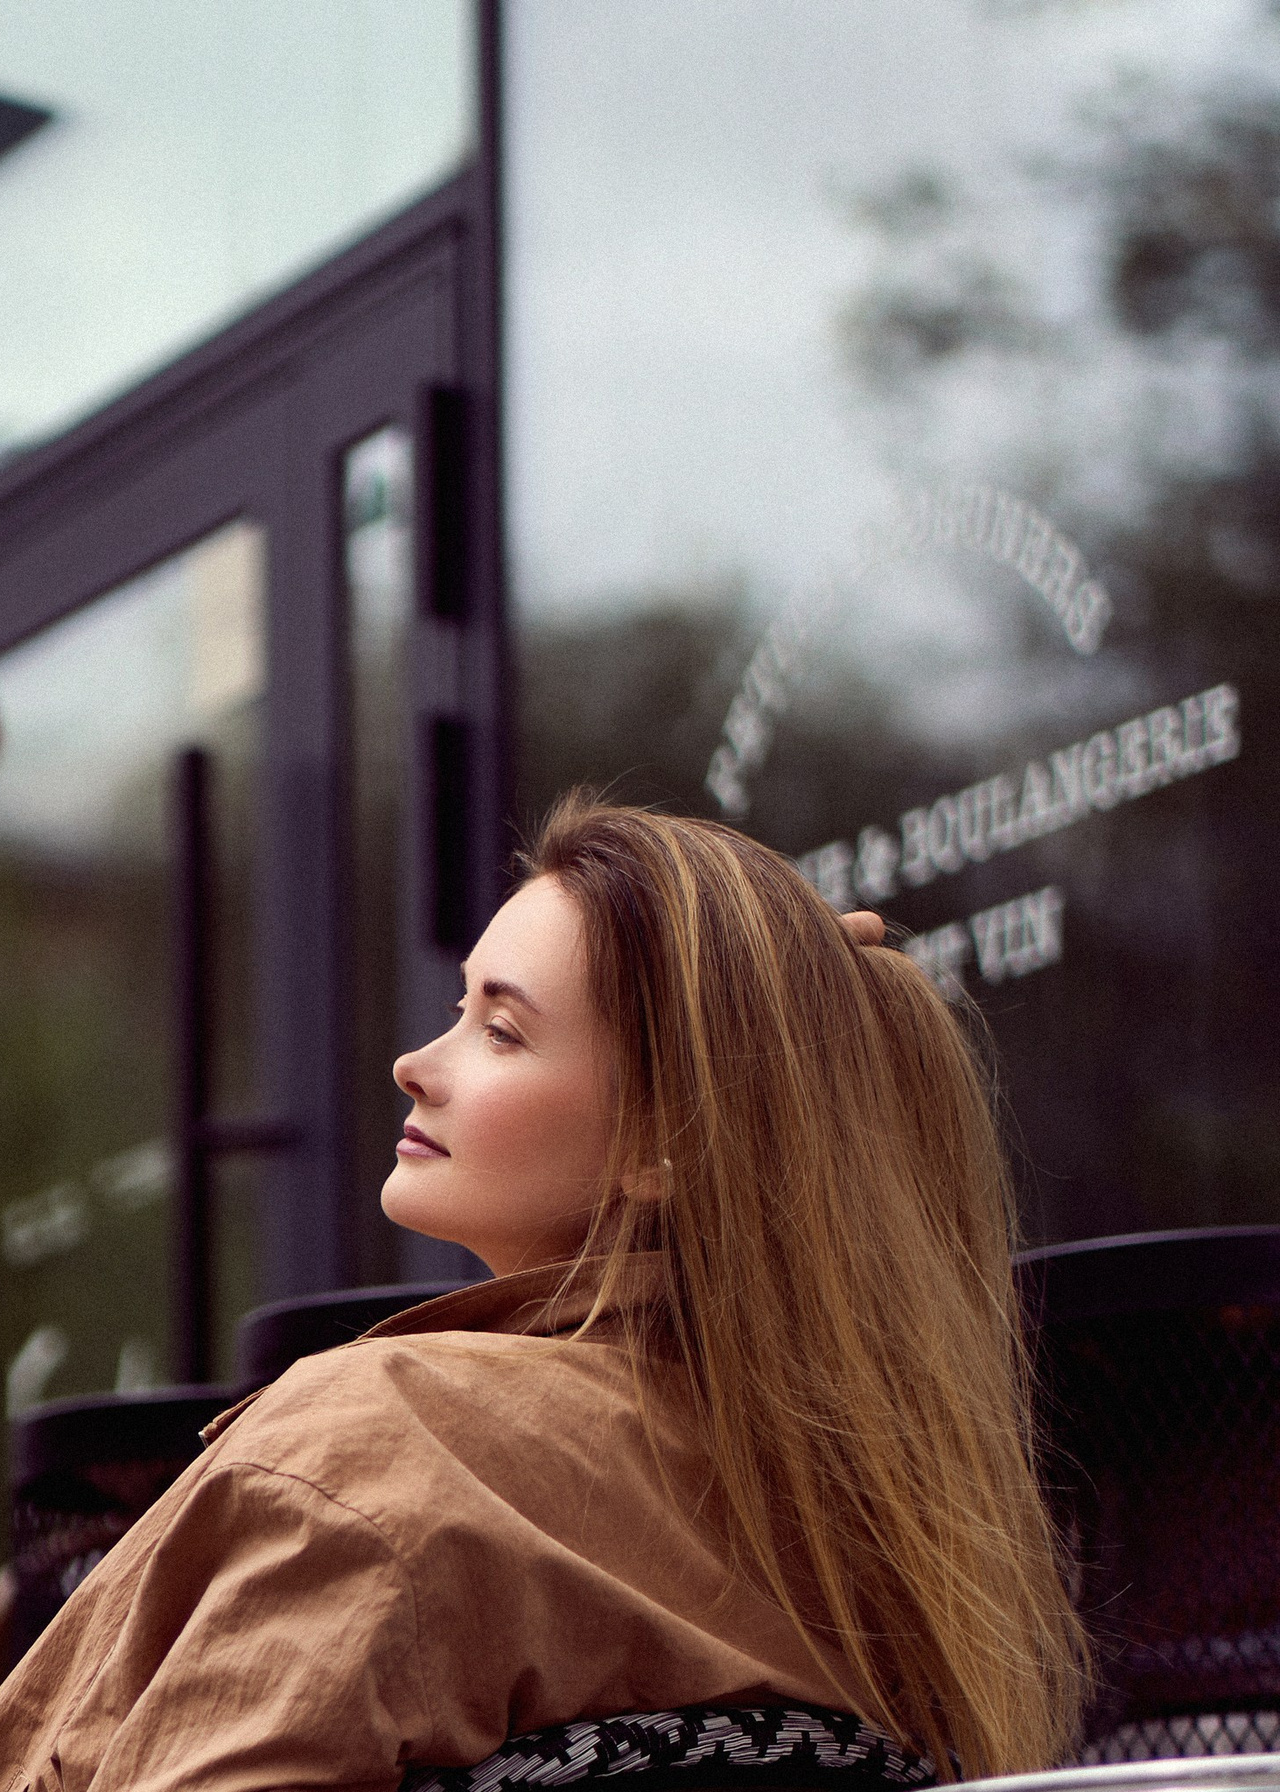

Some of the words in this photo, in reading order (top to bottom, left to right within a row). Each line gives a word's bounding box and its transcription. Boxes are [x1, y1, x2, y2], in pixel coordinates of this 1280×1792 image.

[853, 826, 899, 902] &
[900, 684, 1241, 888] BOULANGERIE
[969, 885, 1064, 985] VIN
